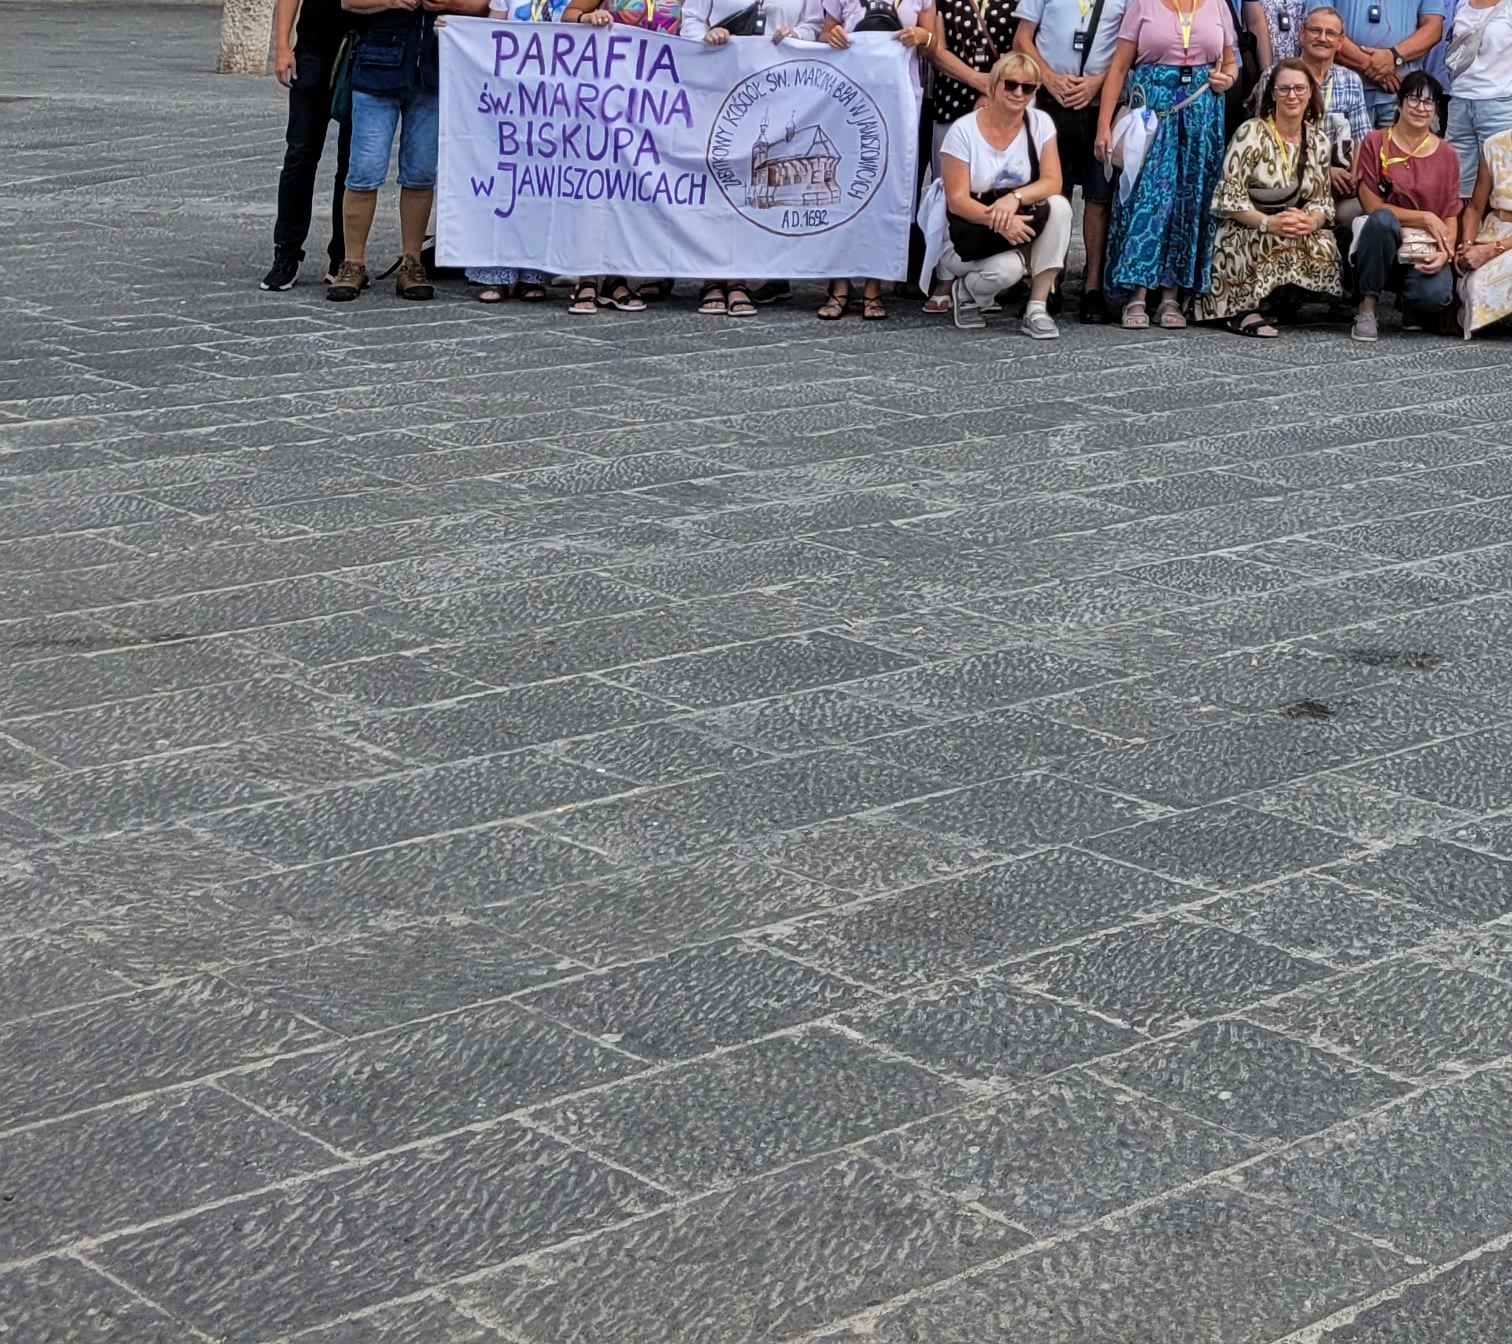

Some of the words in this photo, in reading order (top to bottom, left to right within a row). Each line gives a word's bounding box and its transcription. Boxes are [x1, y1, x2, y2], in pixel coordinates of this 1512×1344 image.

[491, 29, 681, 85] PARAFIA
[518, 80, 694, 129] MARCINA
[722, 81, 768, 127] KOŚCIÓŁ
[765, 70, 791, 92] ŚW.
[498, 119, 661, 167] BISKUPA
[493, 162, 708, 219] JAWISZOWICACH
